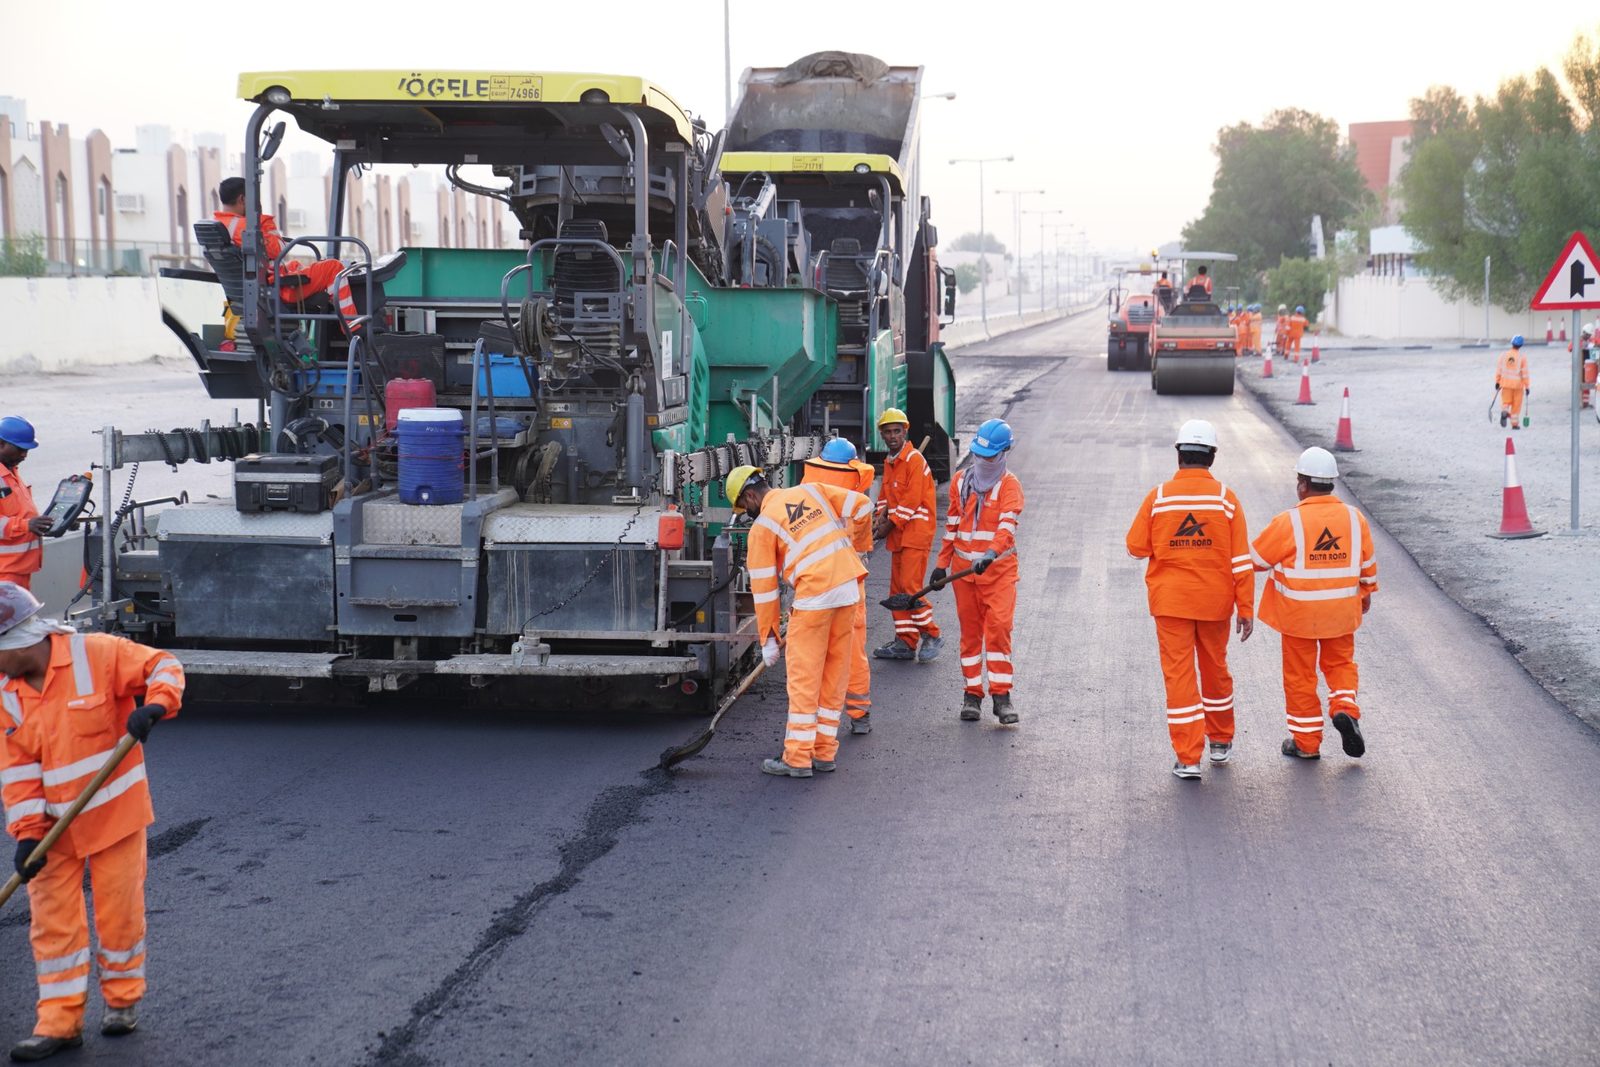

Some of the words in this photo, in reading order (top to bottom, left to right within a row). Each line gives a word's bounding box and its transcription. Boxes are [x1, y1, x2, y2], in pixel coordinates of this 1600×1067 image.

[510, 87, 540, 99] 74966
[790, 519, 808, 533] DELTA
[806, 508, 823, 521] ROAD
[1169, 539, 1190, 547] DELTA
[1191, 538, 1212, 547] ROAD
[1309, 553, 1327, 561] DELTA
[1328, 552, 1347, 561] ROAD
